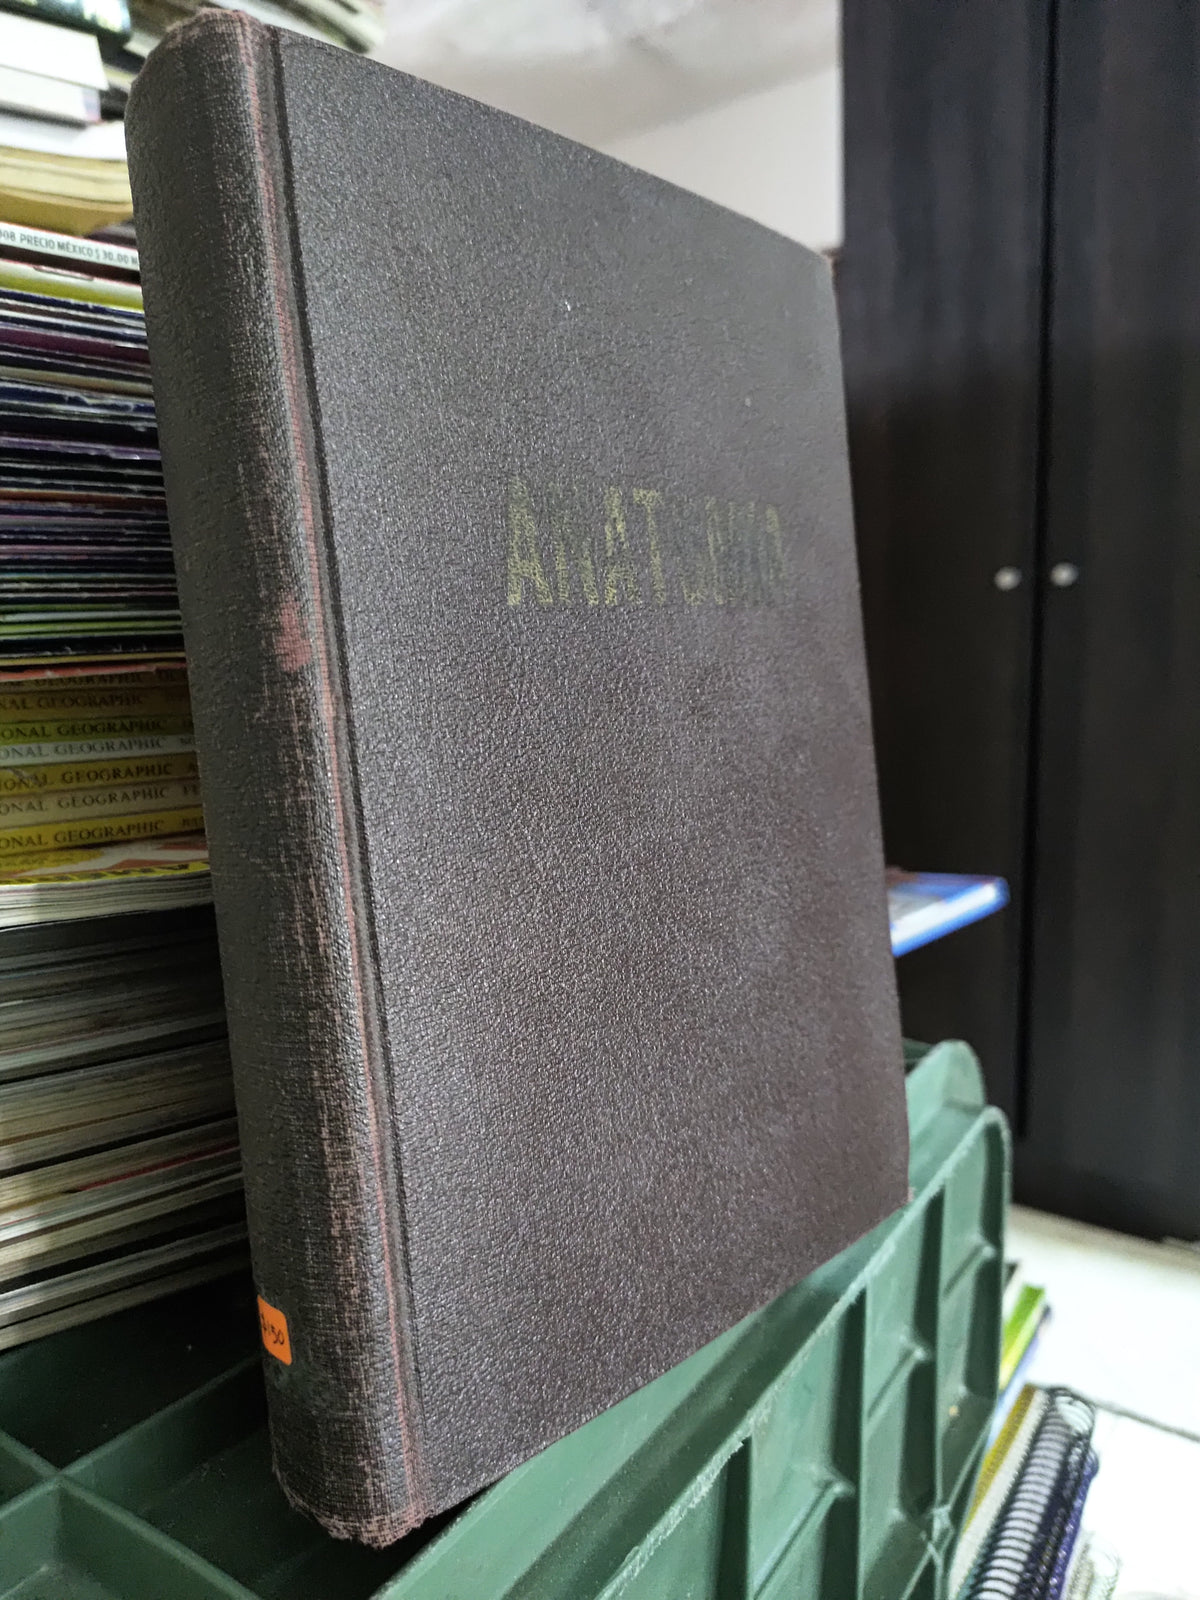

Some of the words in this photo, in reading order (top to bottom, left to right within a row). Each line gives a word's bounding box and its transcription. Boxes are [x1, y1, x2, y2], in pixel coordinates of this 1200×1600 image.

[20, 232, 55, 250] PRECIO
[57, 239, 93, 258] MÉXICO
[57, 720, 167, 736] GEOGRAPHIC
[54, 737, 167, 756] GEOGRAPHIC
[62, 763, 173, 784] GEOGRAPHIC
[58, 786, 169, 809] GEOGRAPHIC
[54, 819, 164, 844] GEOGRAPHIC
